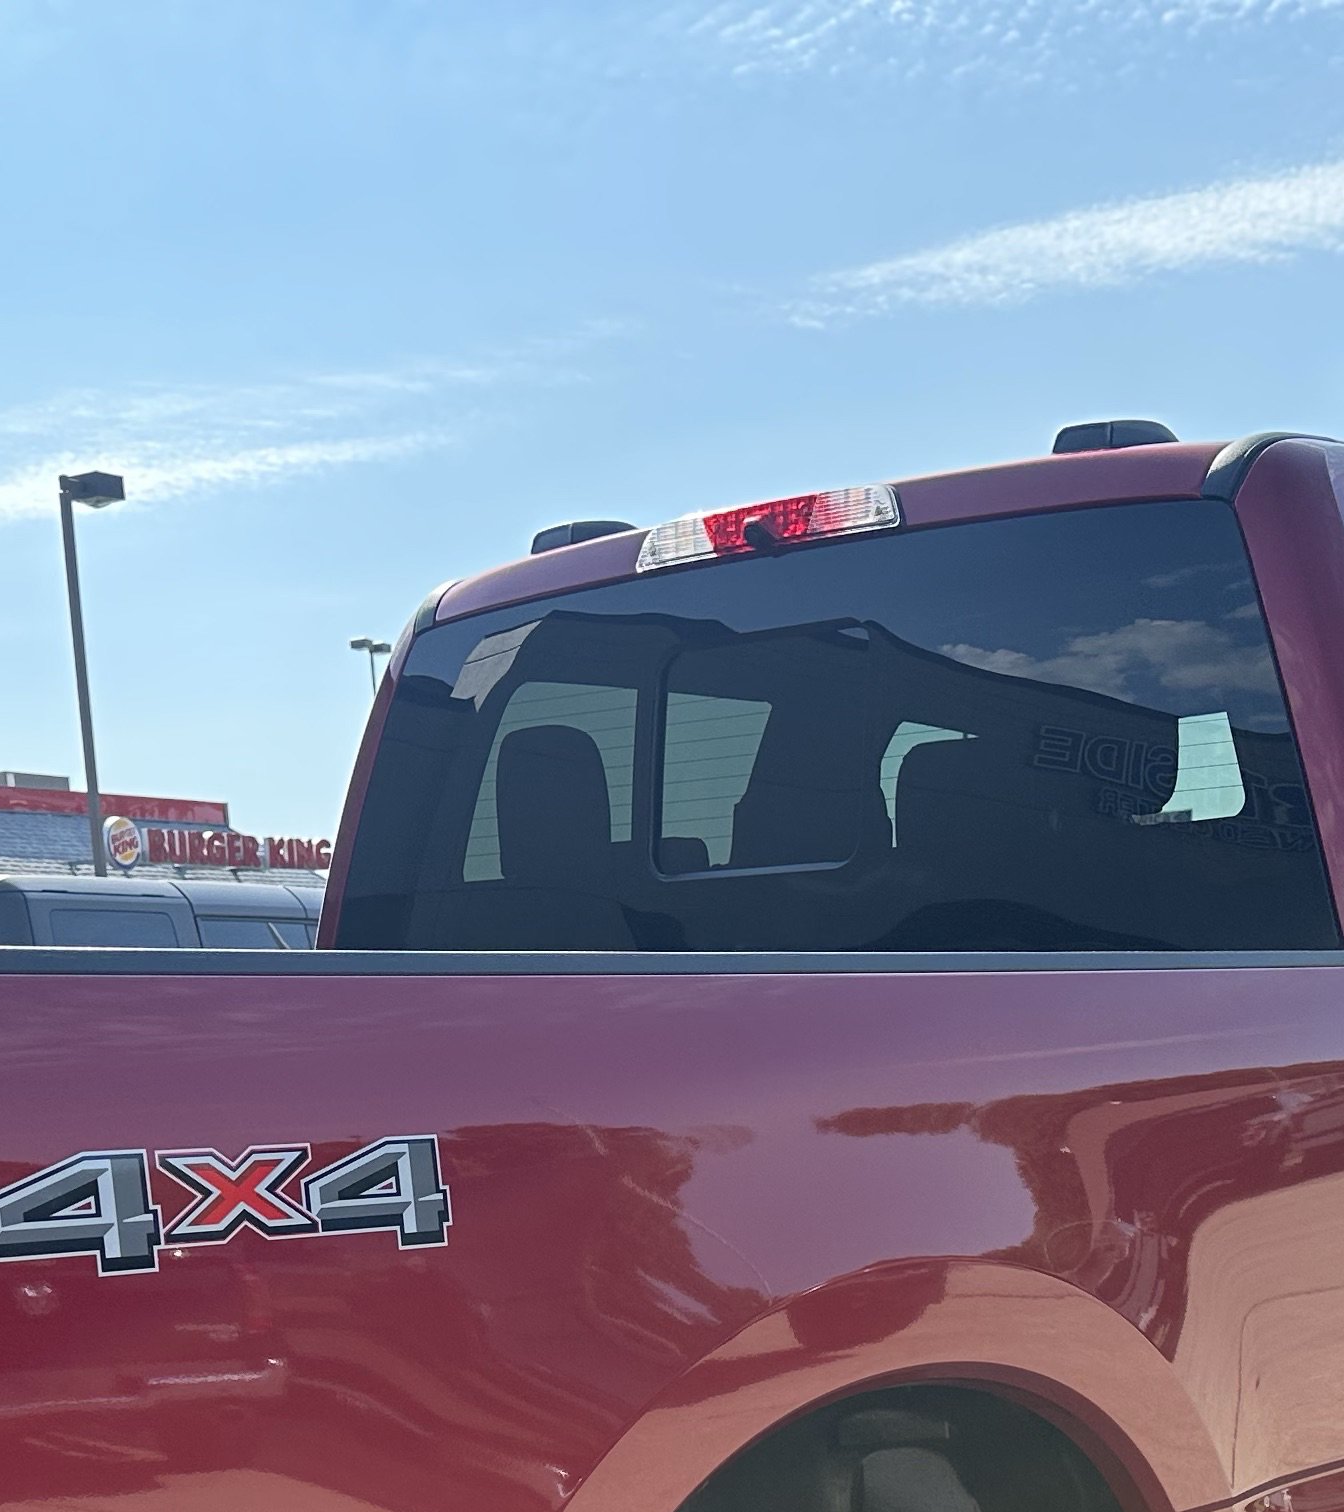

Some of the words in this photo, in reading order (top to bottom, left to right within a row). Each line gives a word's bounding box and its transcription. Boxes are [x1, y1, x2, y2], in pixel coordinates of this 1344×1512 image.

[113, 836, 139, 858] KING
[147, 828, 261, 868] BURGER
[265, 837, 332, 869] KING
